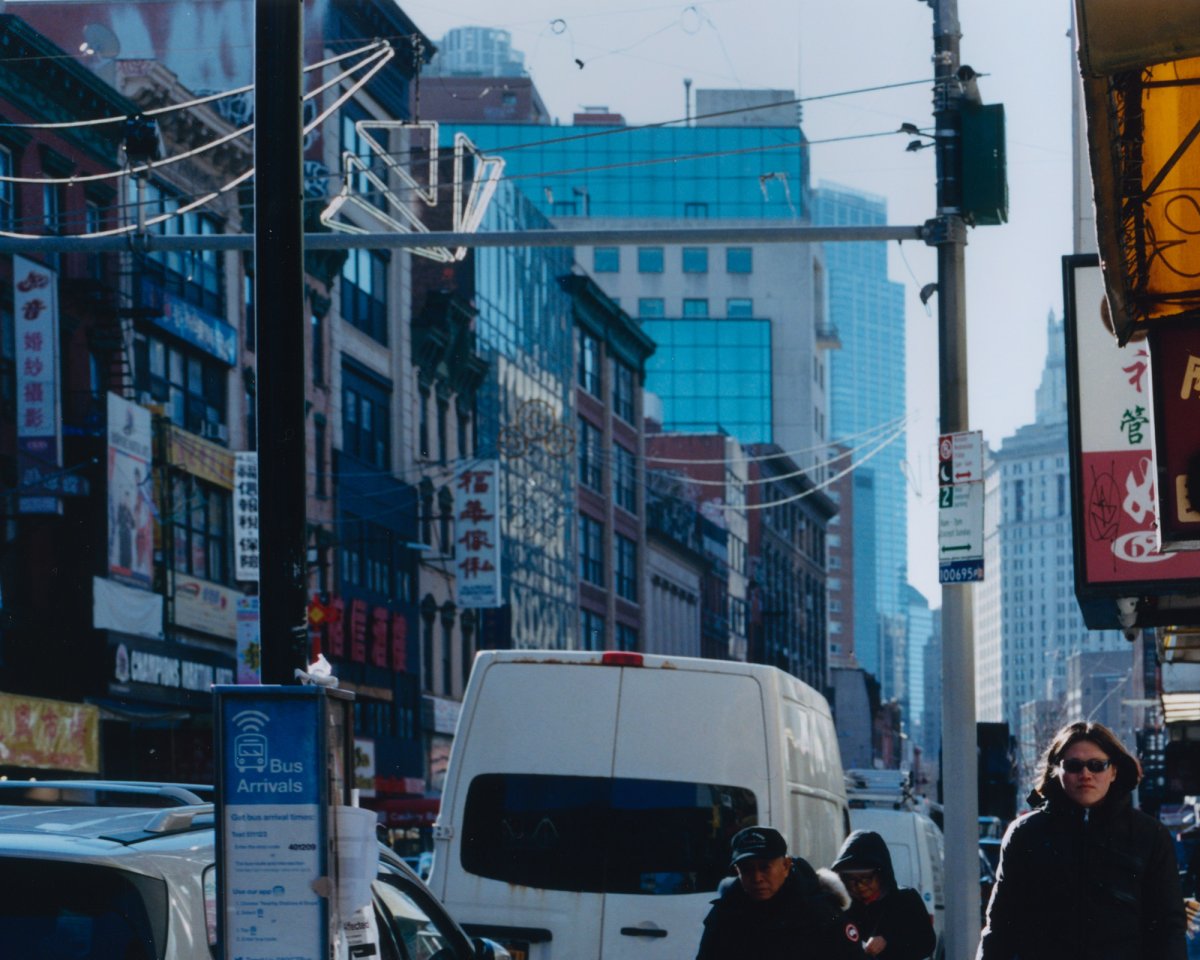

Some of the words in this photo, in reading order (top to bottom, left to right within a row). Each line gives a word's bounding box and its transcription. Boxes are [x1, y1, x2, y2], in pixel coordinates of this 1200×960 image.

[941, 487, 950, 507] 2
[270, 758, 304, 774] Bus
[236, 778, 304, 793] Arrivals
